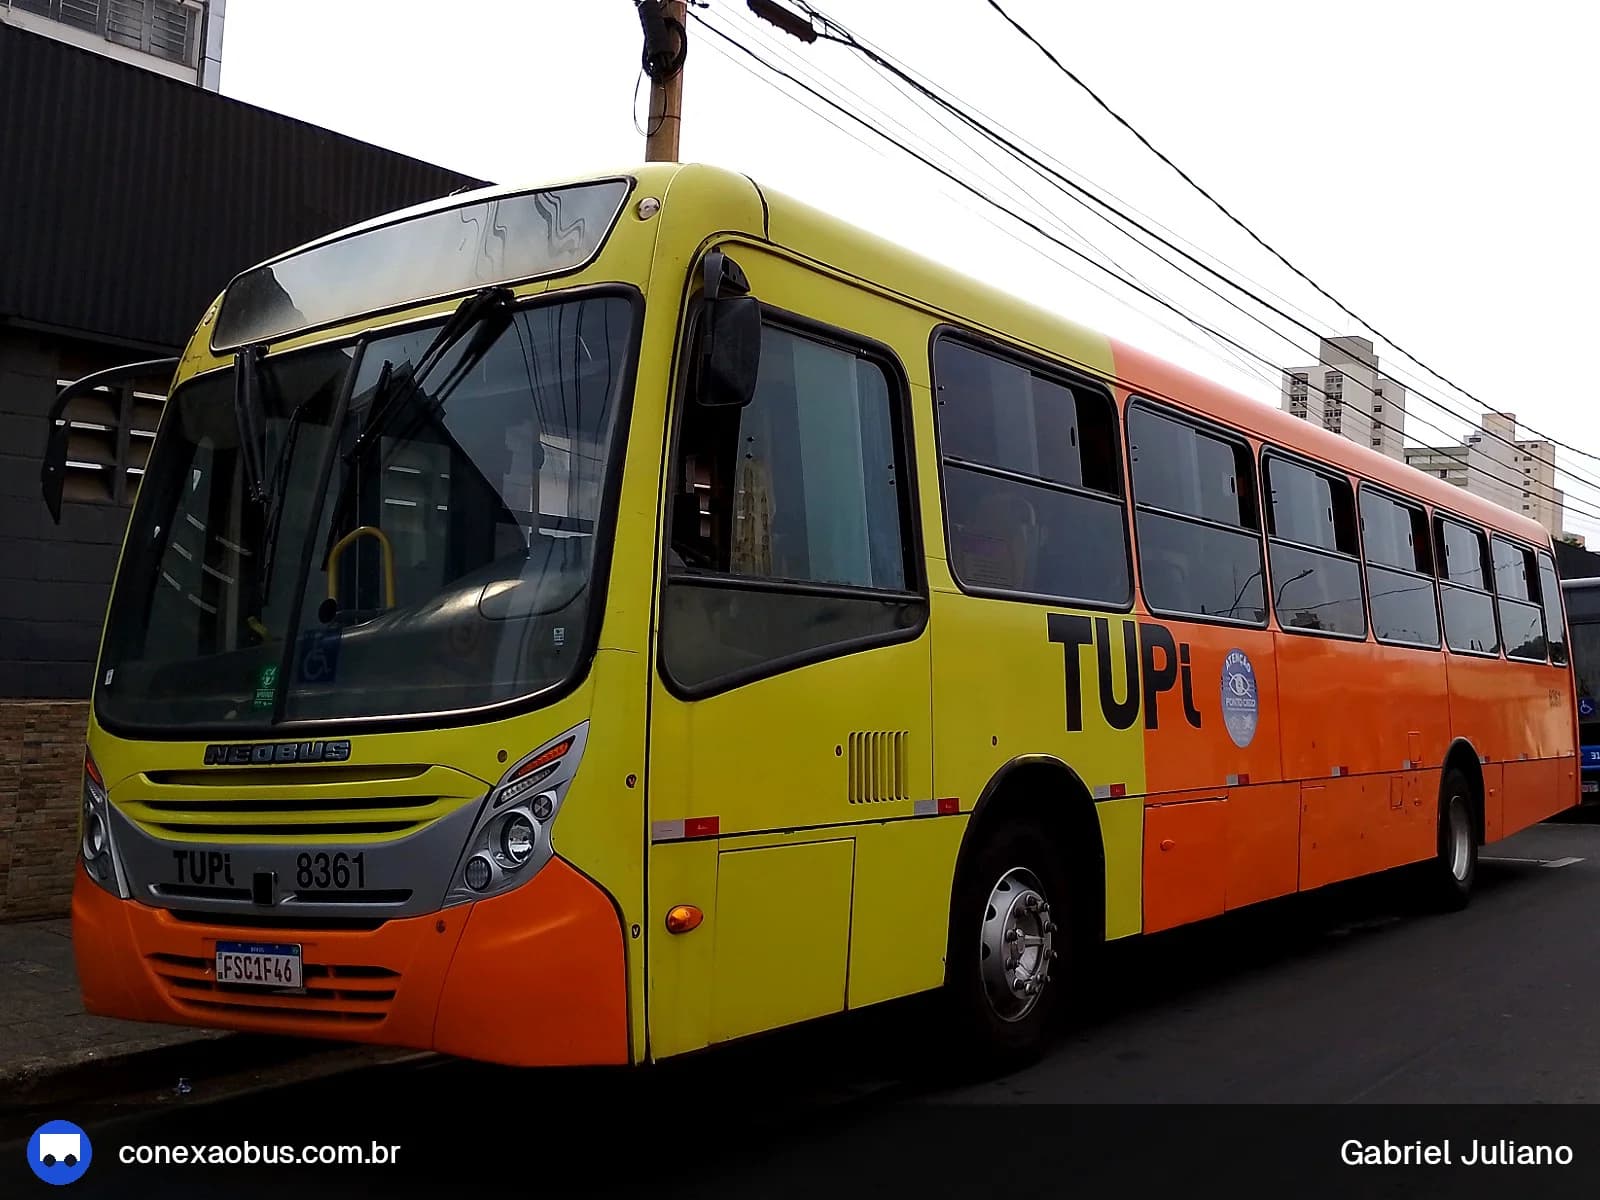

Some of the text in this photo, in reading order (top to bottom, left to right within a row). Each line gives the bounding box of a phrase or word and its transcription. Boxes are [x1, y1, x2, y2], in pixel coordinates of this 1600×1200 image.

[204, 740, 351, 765] NEOBUS
[296, 851, 366, 889] 8361
[223, 954, 292, 983] FSC1F46
